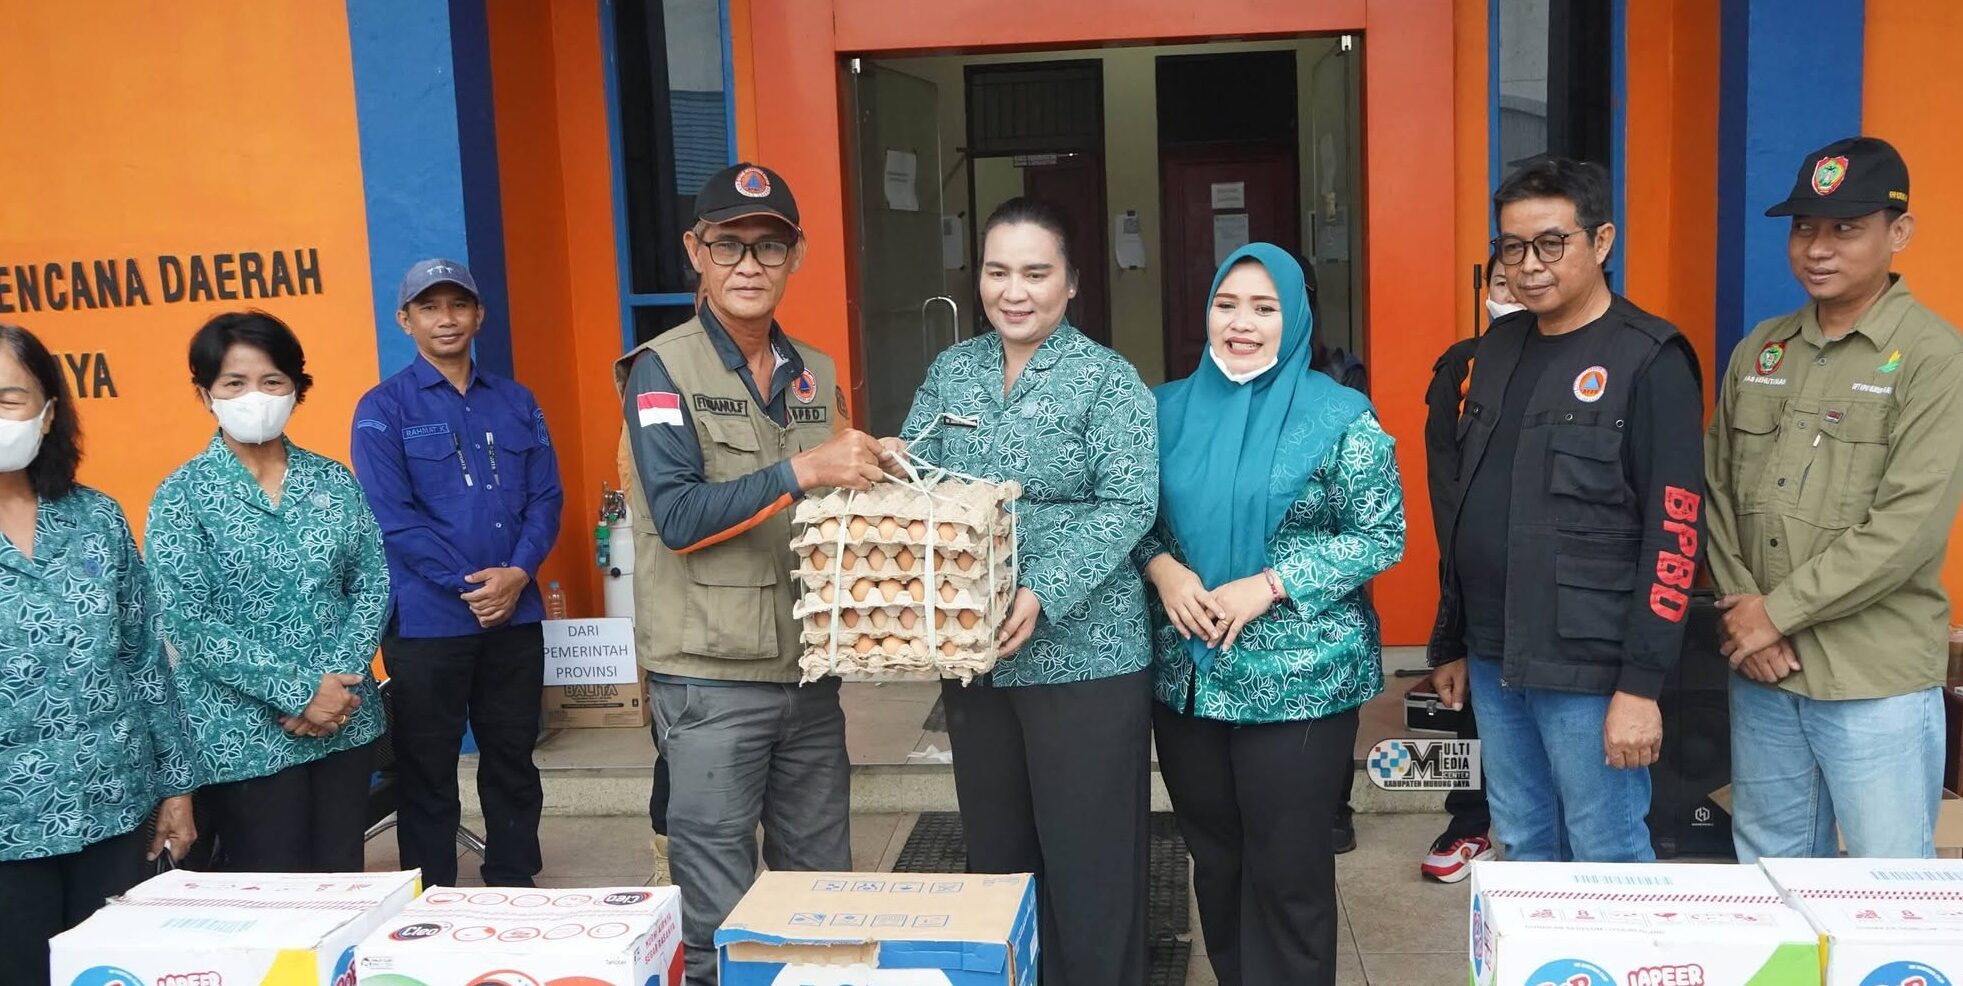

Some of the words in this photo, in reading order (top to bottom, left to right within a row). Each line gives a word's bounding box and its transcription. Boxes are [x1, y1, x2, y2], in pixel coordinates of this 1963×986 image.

[0, 257, 151, 314] ENCANA
[158, 248, 322, 303] DAERAH
[406, 426, 437, 436] RAHMAT
[1650, 485, 1700, 623] BPBD
[568, 625, 599, 637] DARI
[543, 645, 628, 659] PEMERINTAH
[556, 666, 617, 678] PROVINSI
[564, 684, 618, 697] BALITA
[605, 894, 640, 904] Cleo
[401, 925, 439, 937] Cleo
